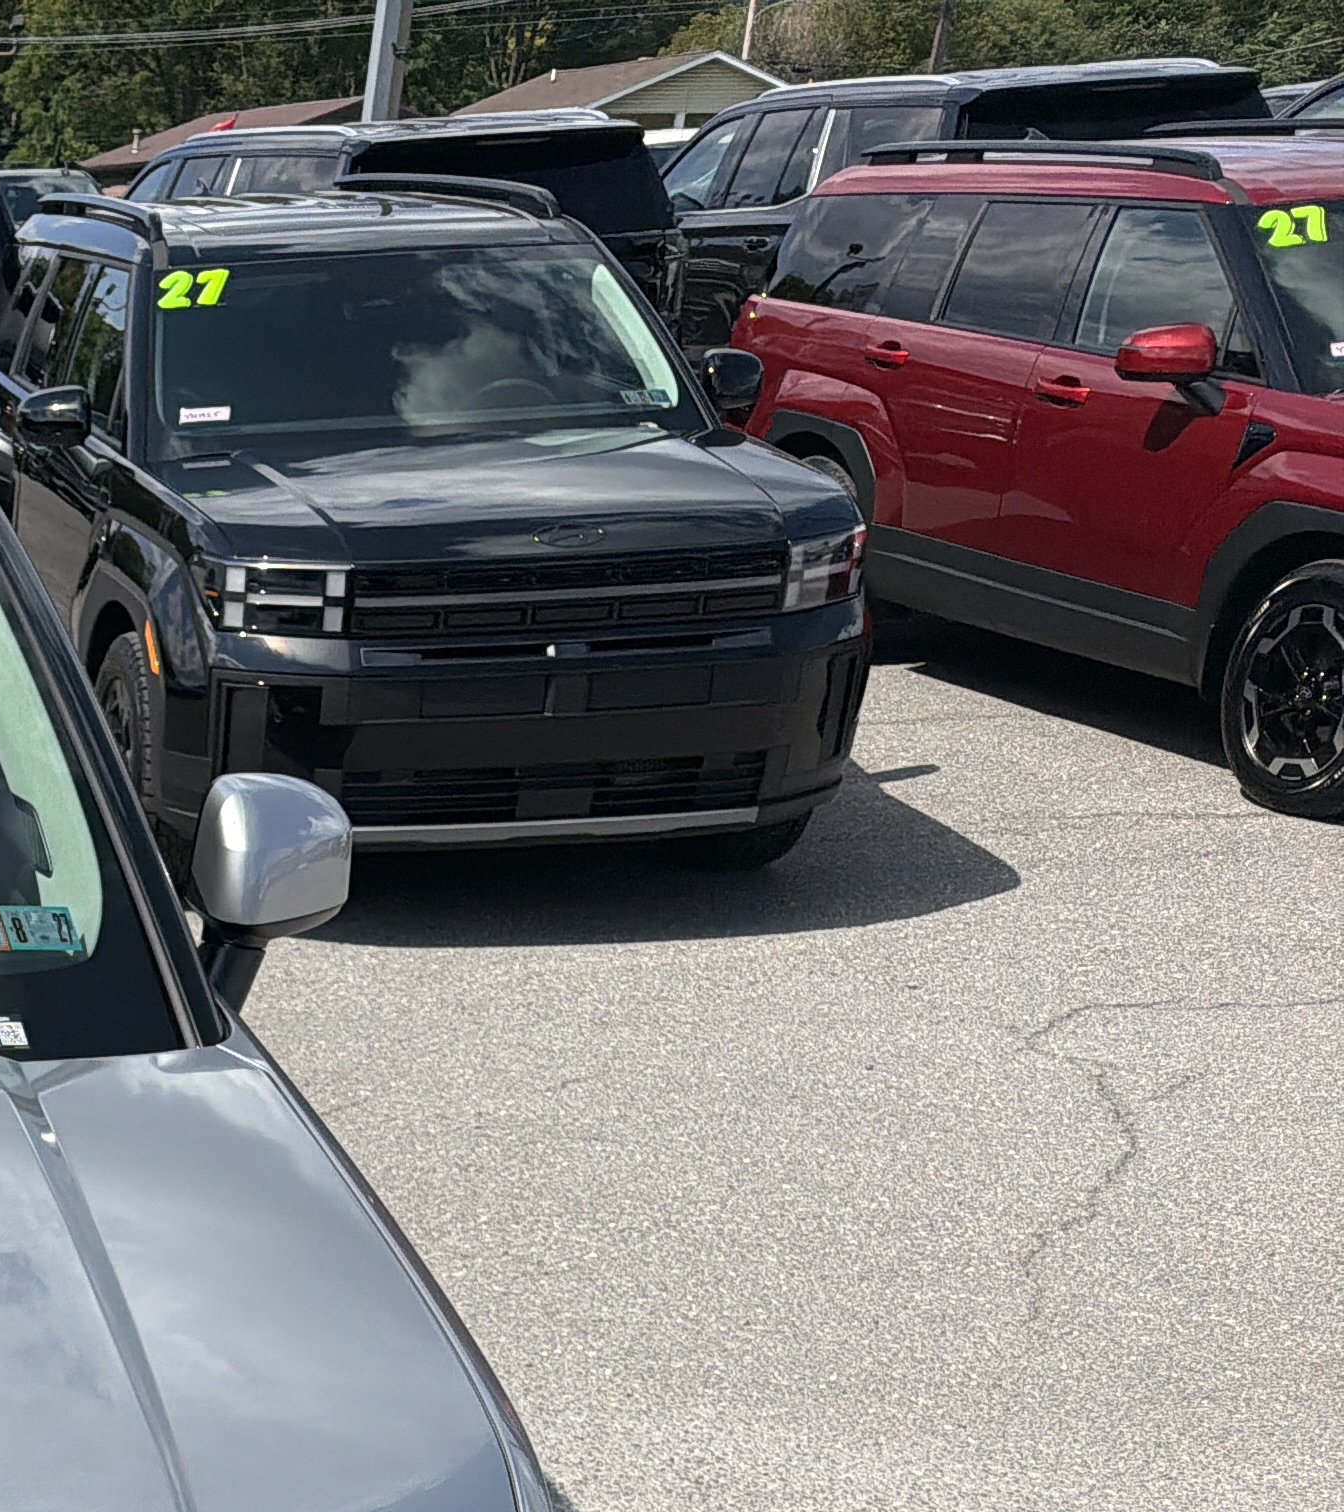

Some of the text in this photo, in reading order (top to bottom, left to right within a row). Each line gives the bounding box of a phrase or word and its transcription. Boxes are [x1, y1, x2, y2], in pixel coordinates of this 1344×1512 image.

[1258, 205, 1328, 248] 27
[157, 268, 230, 309] 27
[11, 912, 74, 945] 8 27
